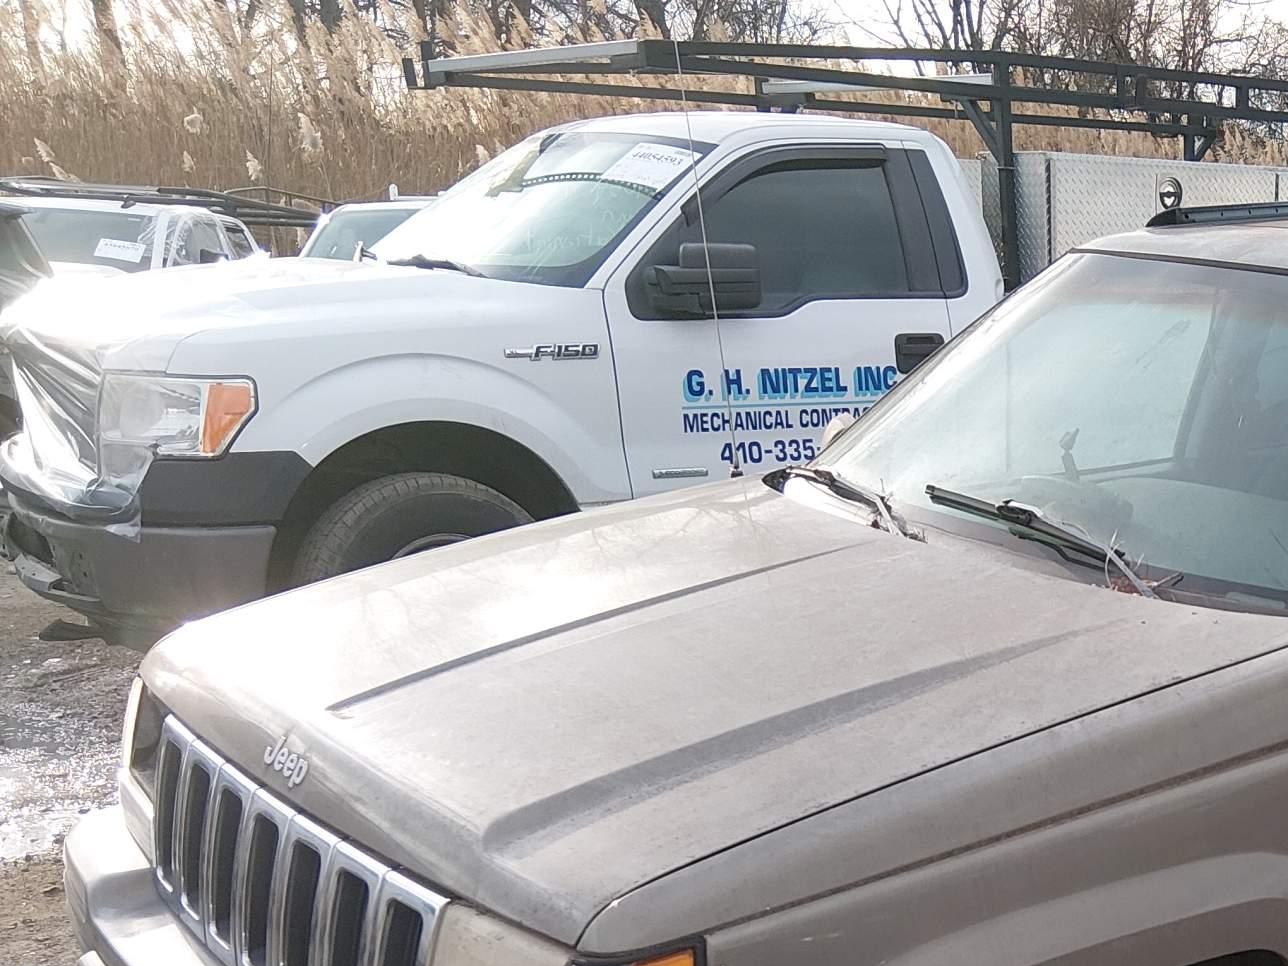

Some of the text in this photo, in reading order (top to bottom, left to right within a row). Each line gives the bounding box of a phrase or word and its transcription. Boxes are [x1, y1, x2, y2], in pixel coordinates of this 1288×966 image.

[533, 343, 600, 361] F-150
[758, 366, 848, 397] NITZEL
[683, 410, 793, 433] MECHANICAL
[264, 735, 308, 788] Jeep
